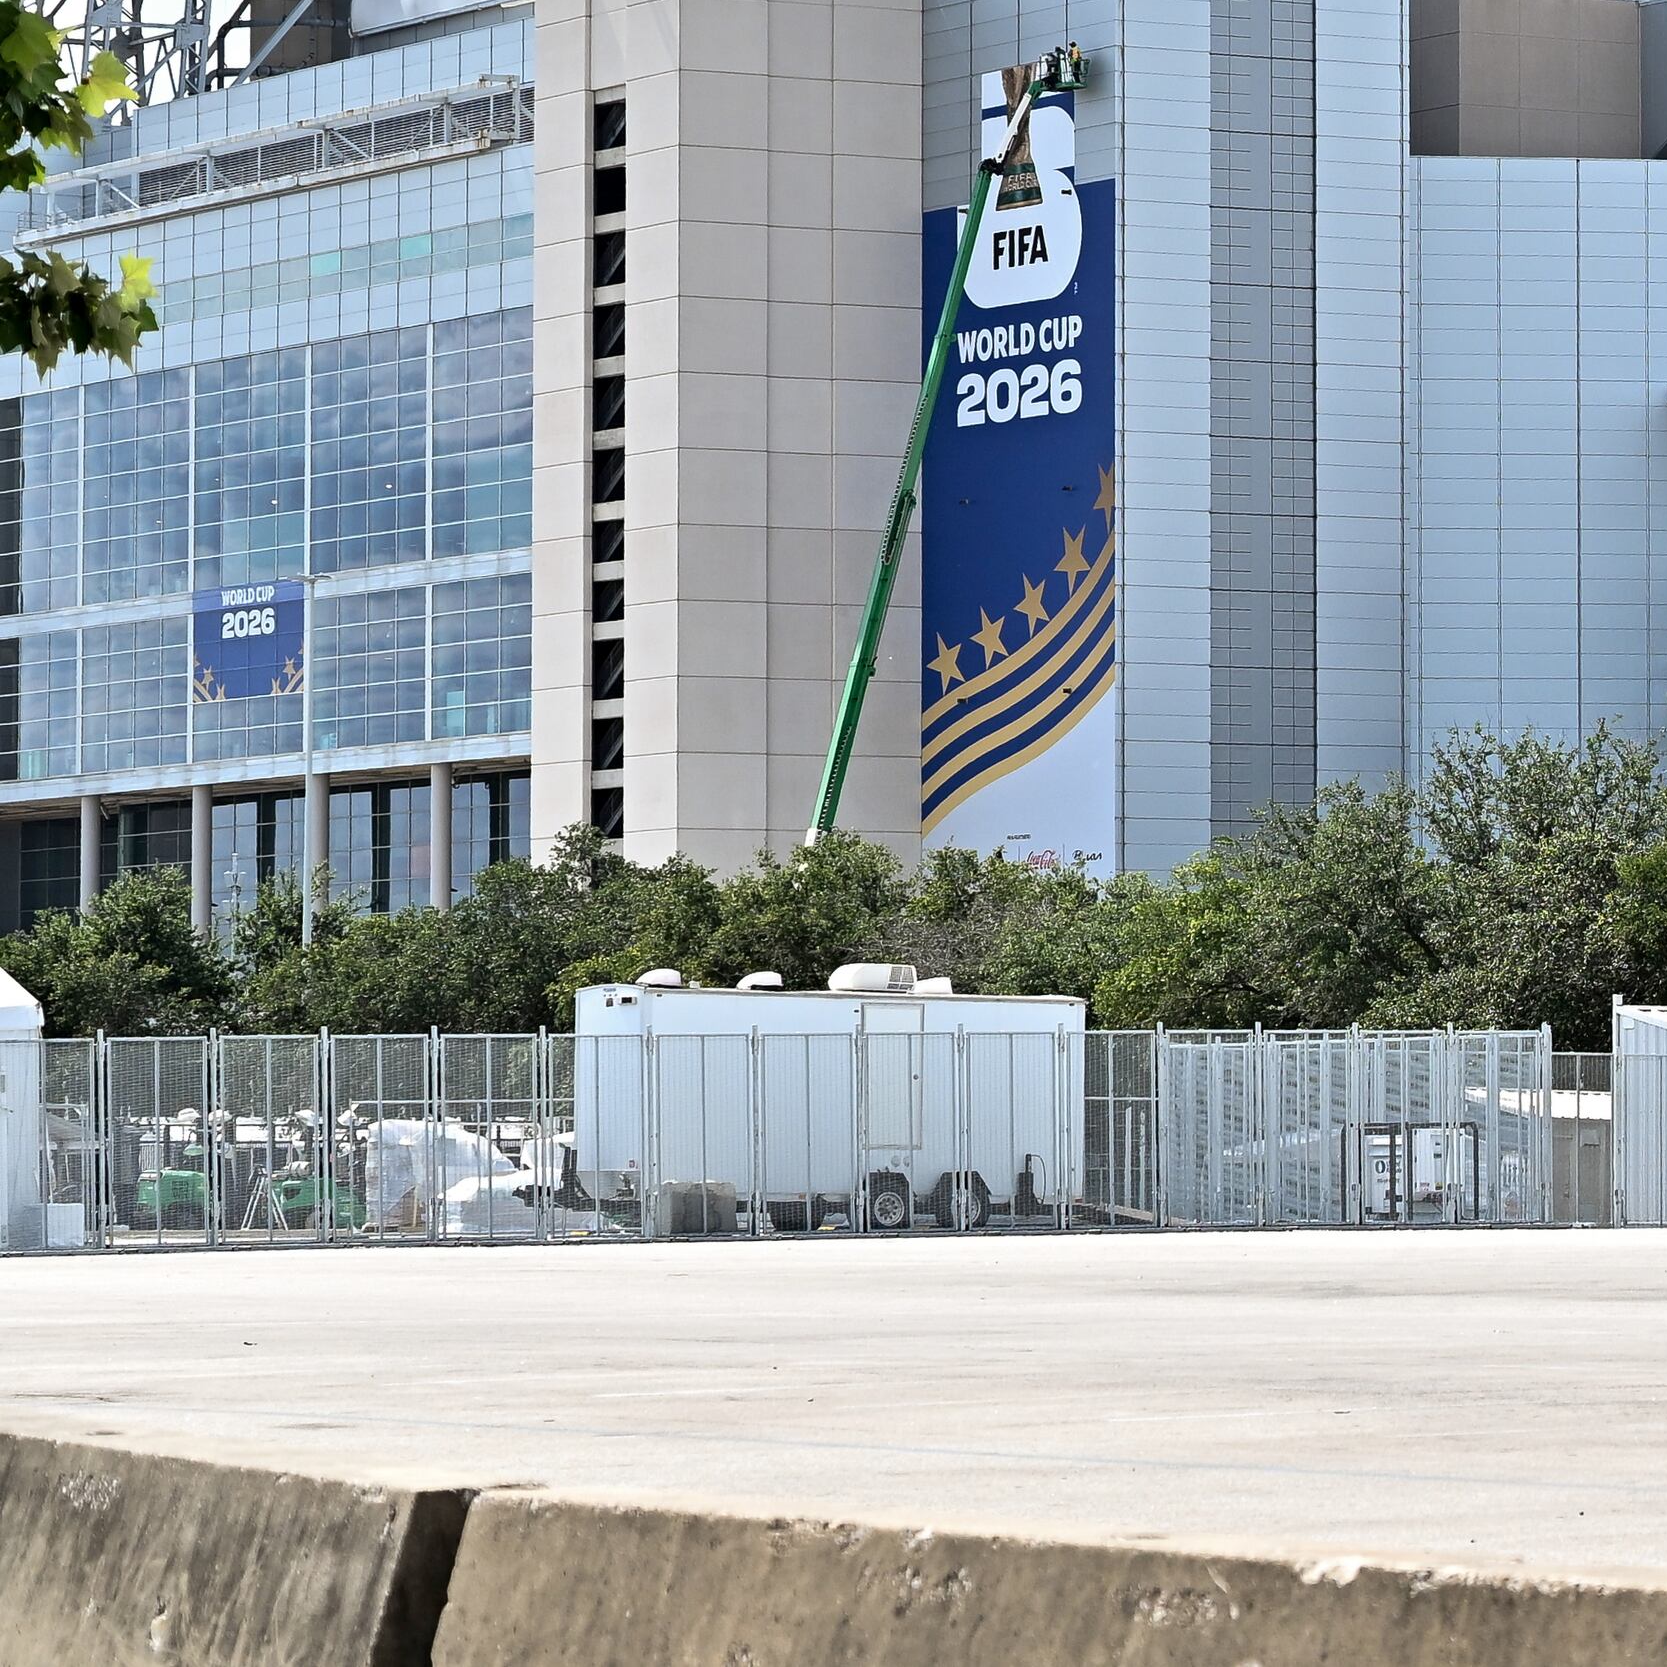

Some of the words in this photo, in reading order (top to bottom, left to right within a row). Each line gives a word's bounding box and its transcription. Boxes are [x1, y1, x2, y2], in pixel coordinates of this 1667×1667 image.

[992, 225, 1048, 270] FIFA
[957, 322, 1036, 364] WORLD
[1039, 315, 1083, 353] CUP
[956, 358, 1083, 428] 2026
[221, 587, 255, 606] WORLD
[256, 585, 275, 603] CUP
[221, 607, 275, 639] 2026
